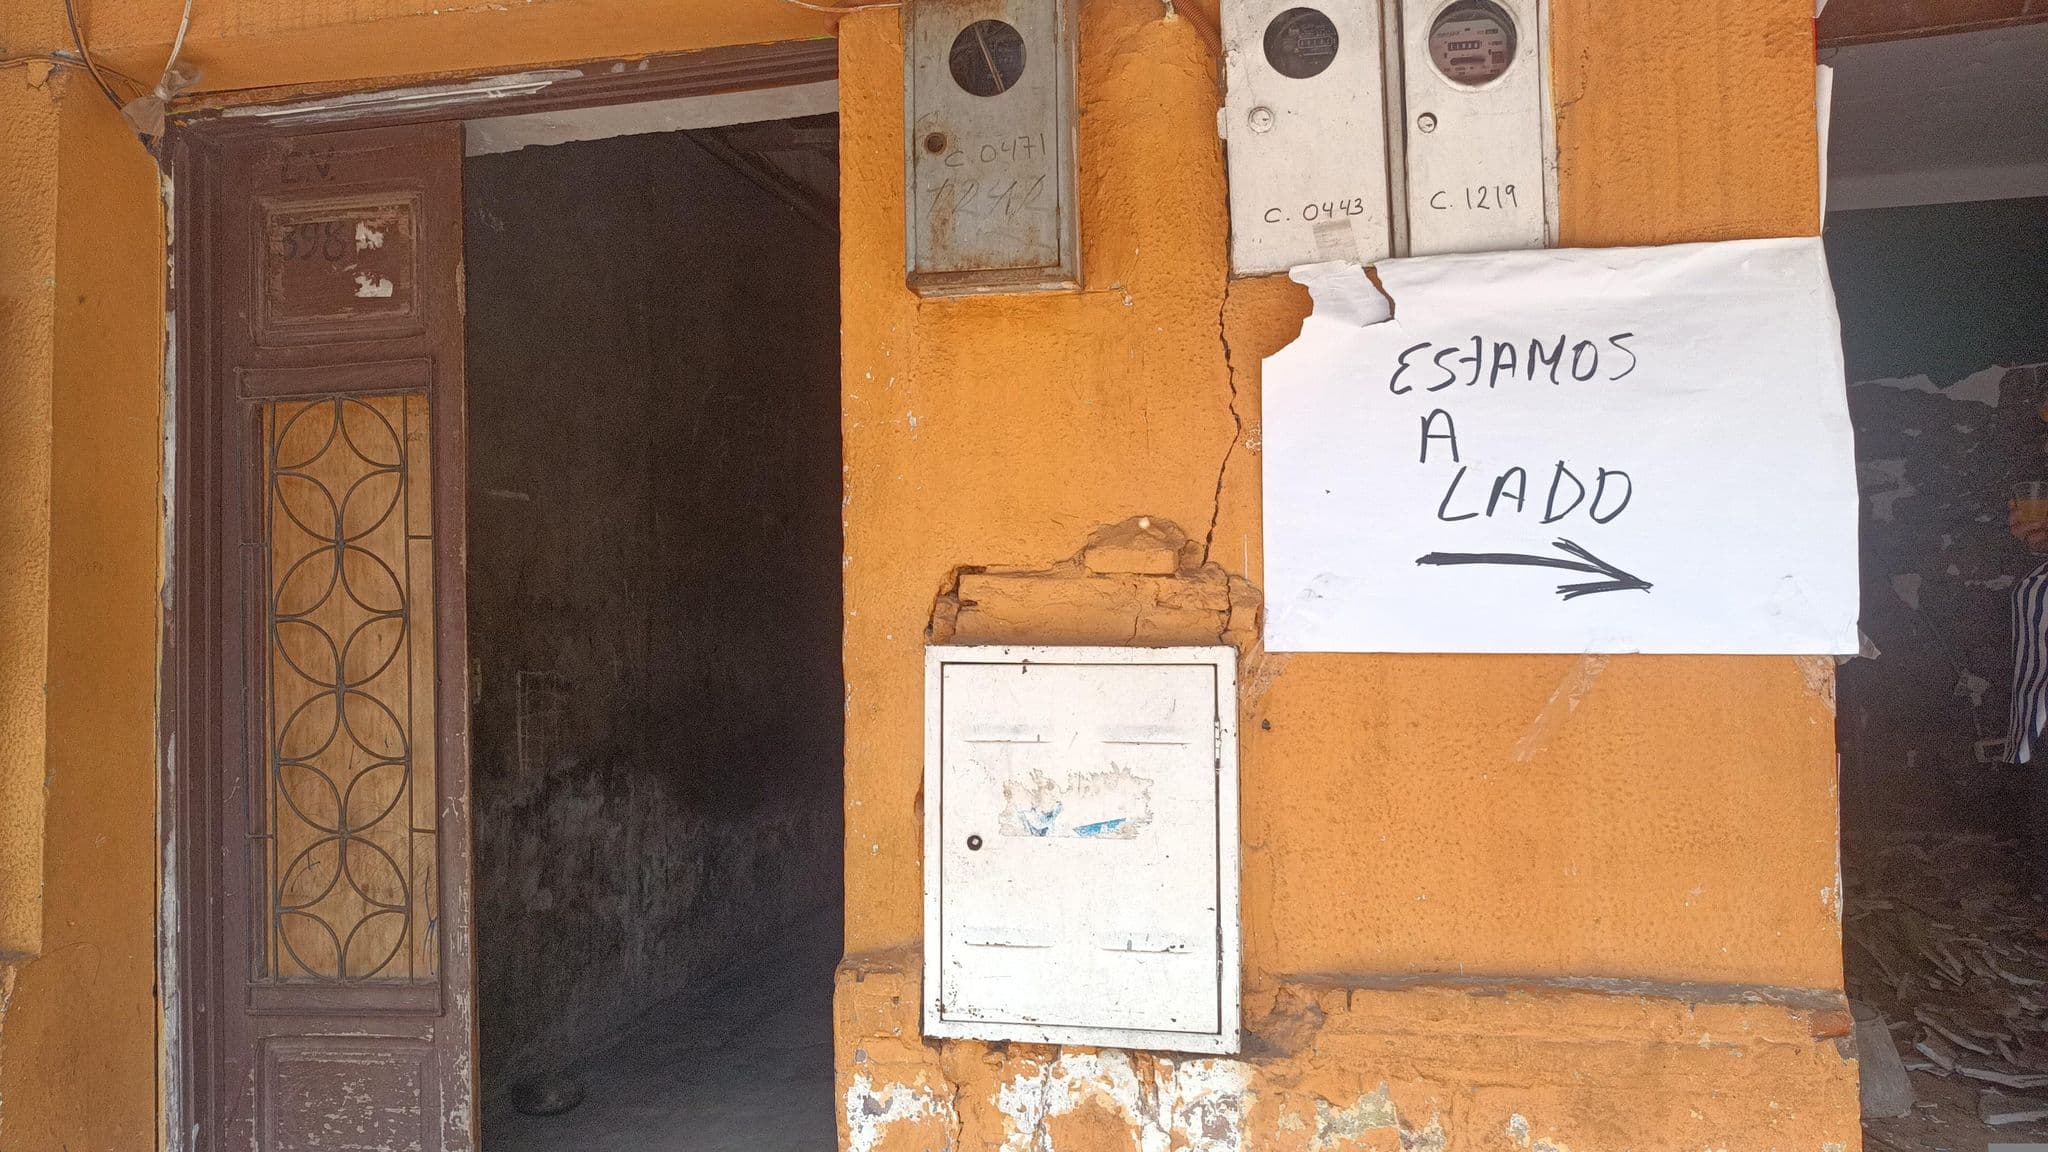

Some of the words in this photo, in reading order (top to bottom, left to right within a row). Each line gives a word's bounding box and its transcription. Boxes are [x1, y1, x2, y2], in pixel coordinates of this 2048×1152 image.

[980, 133, 1046, 162] 0471
[1264, 207, 1291, 223] C.
[1302, 198, 1364, 221] 0443
[1430, 191, 1453, 209] C.
[1466, 184, 1518, 210] 1219
[1389, 332, 1637, 395] ESTAMOS
[1420, 408, 1459, 464] A
[1437, 459, 1633, 524] LADO
